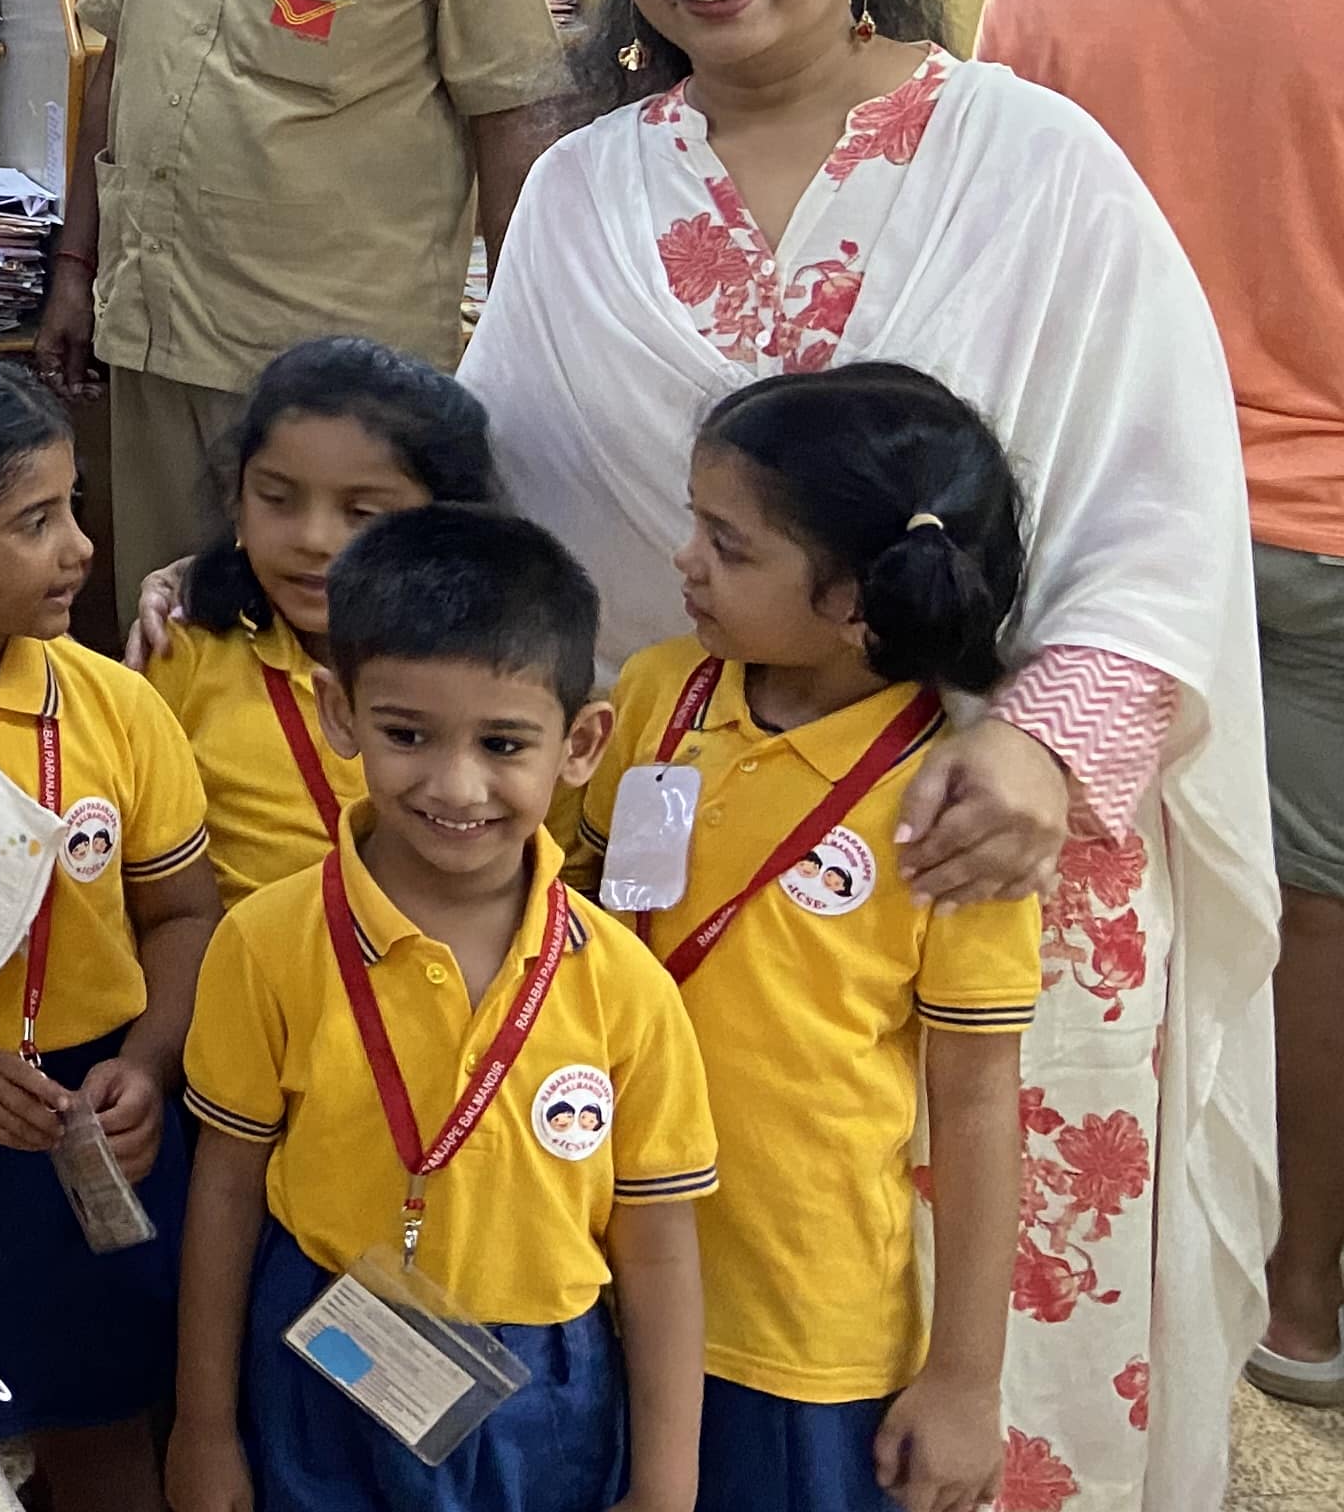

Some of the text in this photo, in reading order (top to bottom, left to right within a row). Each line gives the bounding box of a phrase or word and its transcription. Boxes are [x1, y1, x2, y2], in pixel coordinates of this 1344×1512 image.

[44, 750, 54, 809] PARANJAP
[790, 885, 822, 910] ICSE
[514, 977, 546, 1029] RAMABAI
[541, 911, 566, 977] PARANJAPE
[458, 1059, 504, 1128] BALMANDIR
